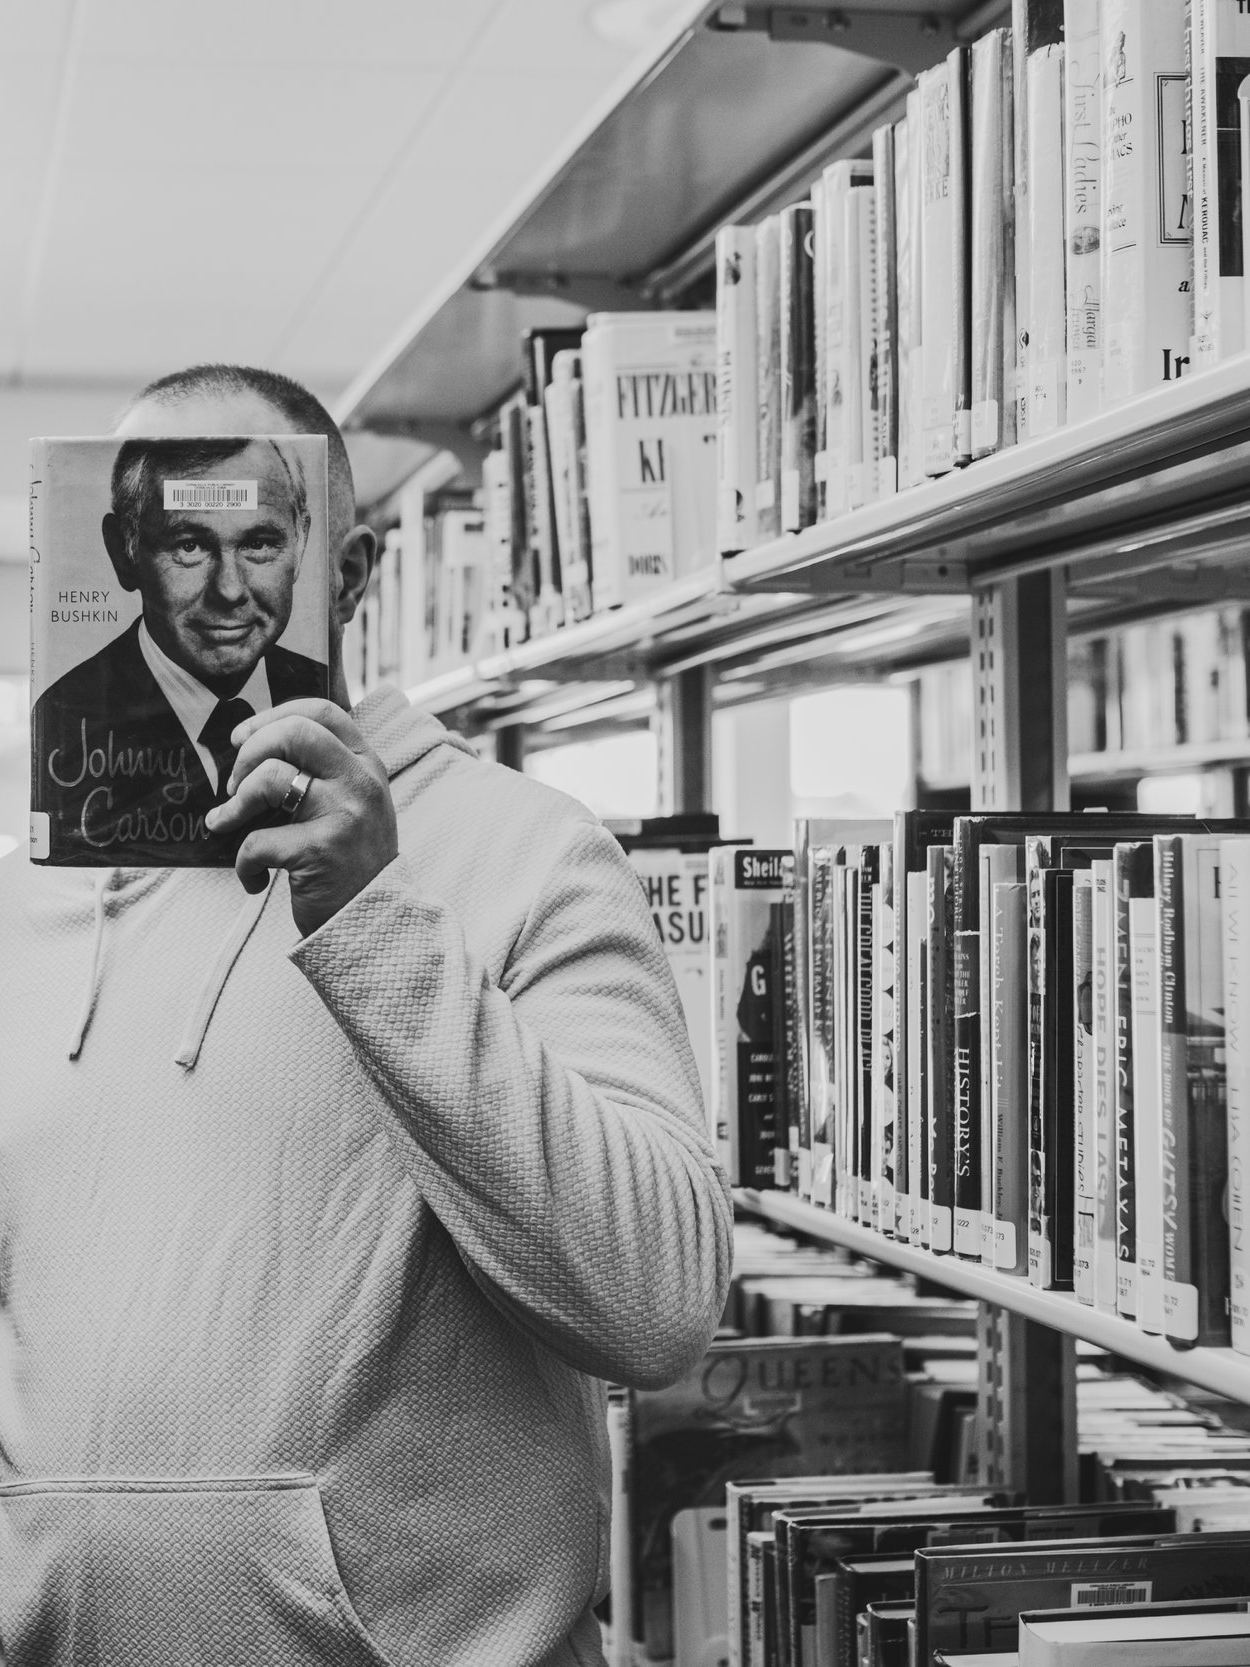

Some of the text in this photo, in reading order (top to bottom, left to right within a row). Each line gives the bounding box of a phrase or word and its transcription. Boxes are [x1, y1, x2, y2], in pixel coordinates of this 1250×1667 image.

[1200, 88, 1208, 146] AWAKENER
[1200, 197, 1209, 244] KEROUAC
[50, 610, 119, 623] BUSHKIN
[58, 591, 110, 604] HENRY
[48, 717, 193, 805] Johnny
[81, 786, 211, 847] Carson
[1116, 909, 1128, 989] MEN
[1161, 851, 1176, 1024] Hillary Rodham Clinton
[1095, 947, 1108, 1035] HOPE
[1228, 956, 1241, 1052] KNOW
[1095, 1044, 1108, 1118] DIES
[1116, 1016, 1129, 1090] ERIC
[956, 1047, 971, 1178] HISTORY'S
[1117, 1107, 1130, 1259] METAXAS
[1161, 1127, 1177, 1229] GUTSY
[1230, 1156, 1244, 1250] COHEN
[941, 1556, 1149, 1580] MILTON MELTZER
